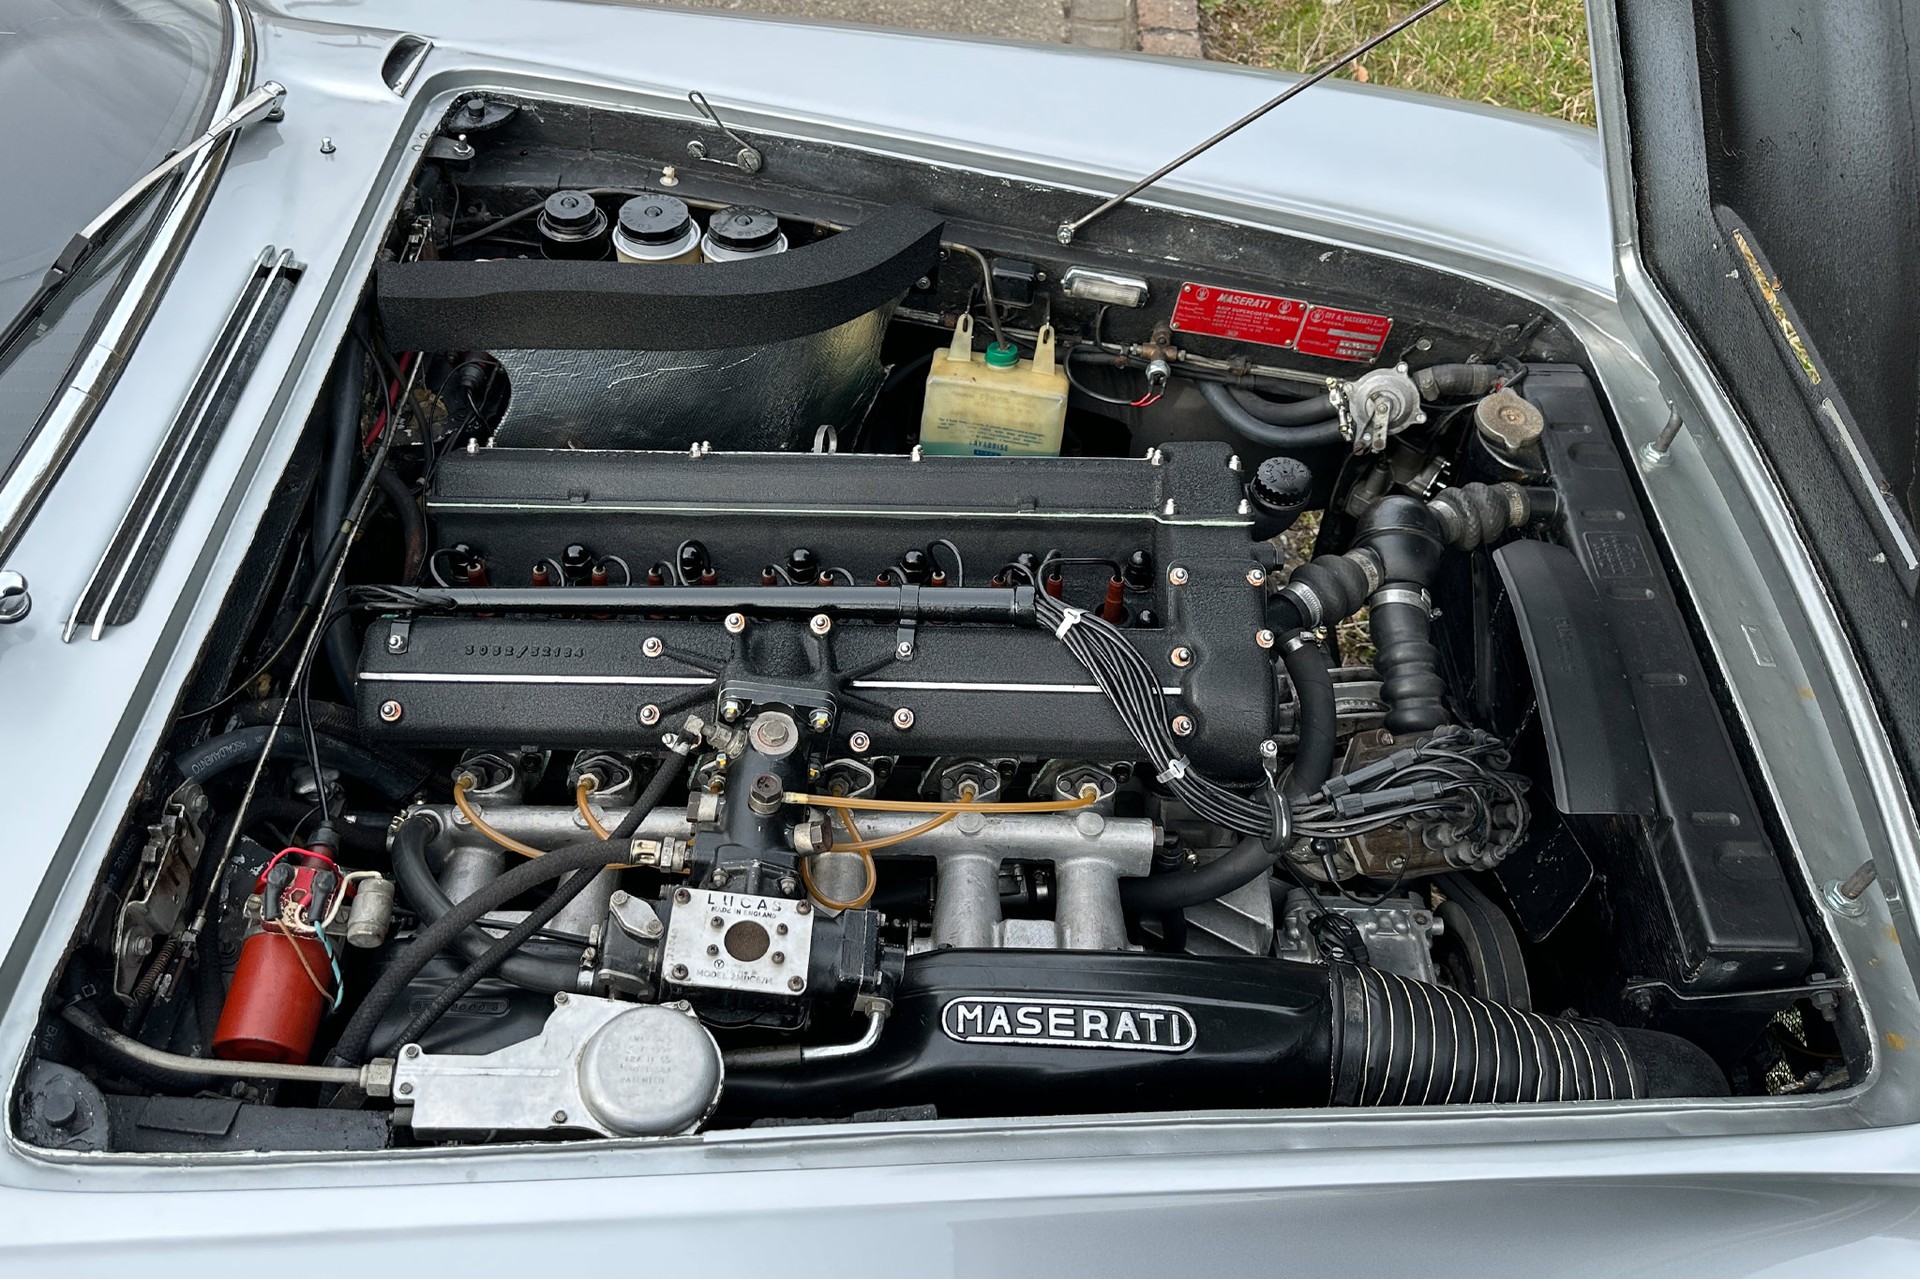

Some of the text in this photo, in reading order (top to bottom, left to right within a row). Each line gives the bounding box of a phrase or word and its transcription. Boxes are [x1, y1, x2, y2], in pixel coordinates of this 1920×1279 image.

[1216, 293, 1272, 309] MASERATI
[707, 893, 782, 912] LUCAS
[956, 1004, 1181, 1044] MASERATI
